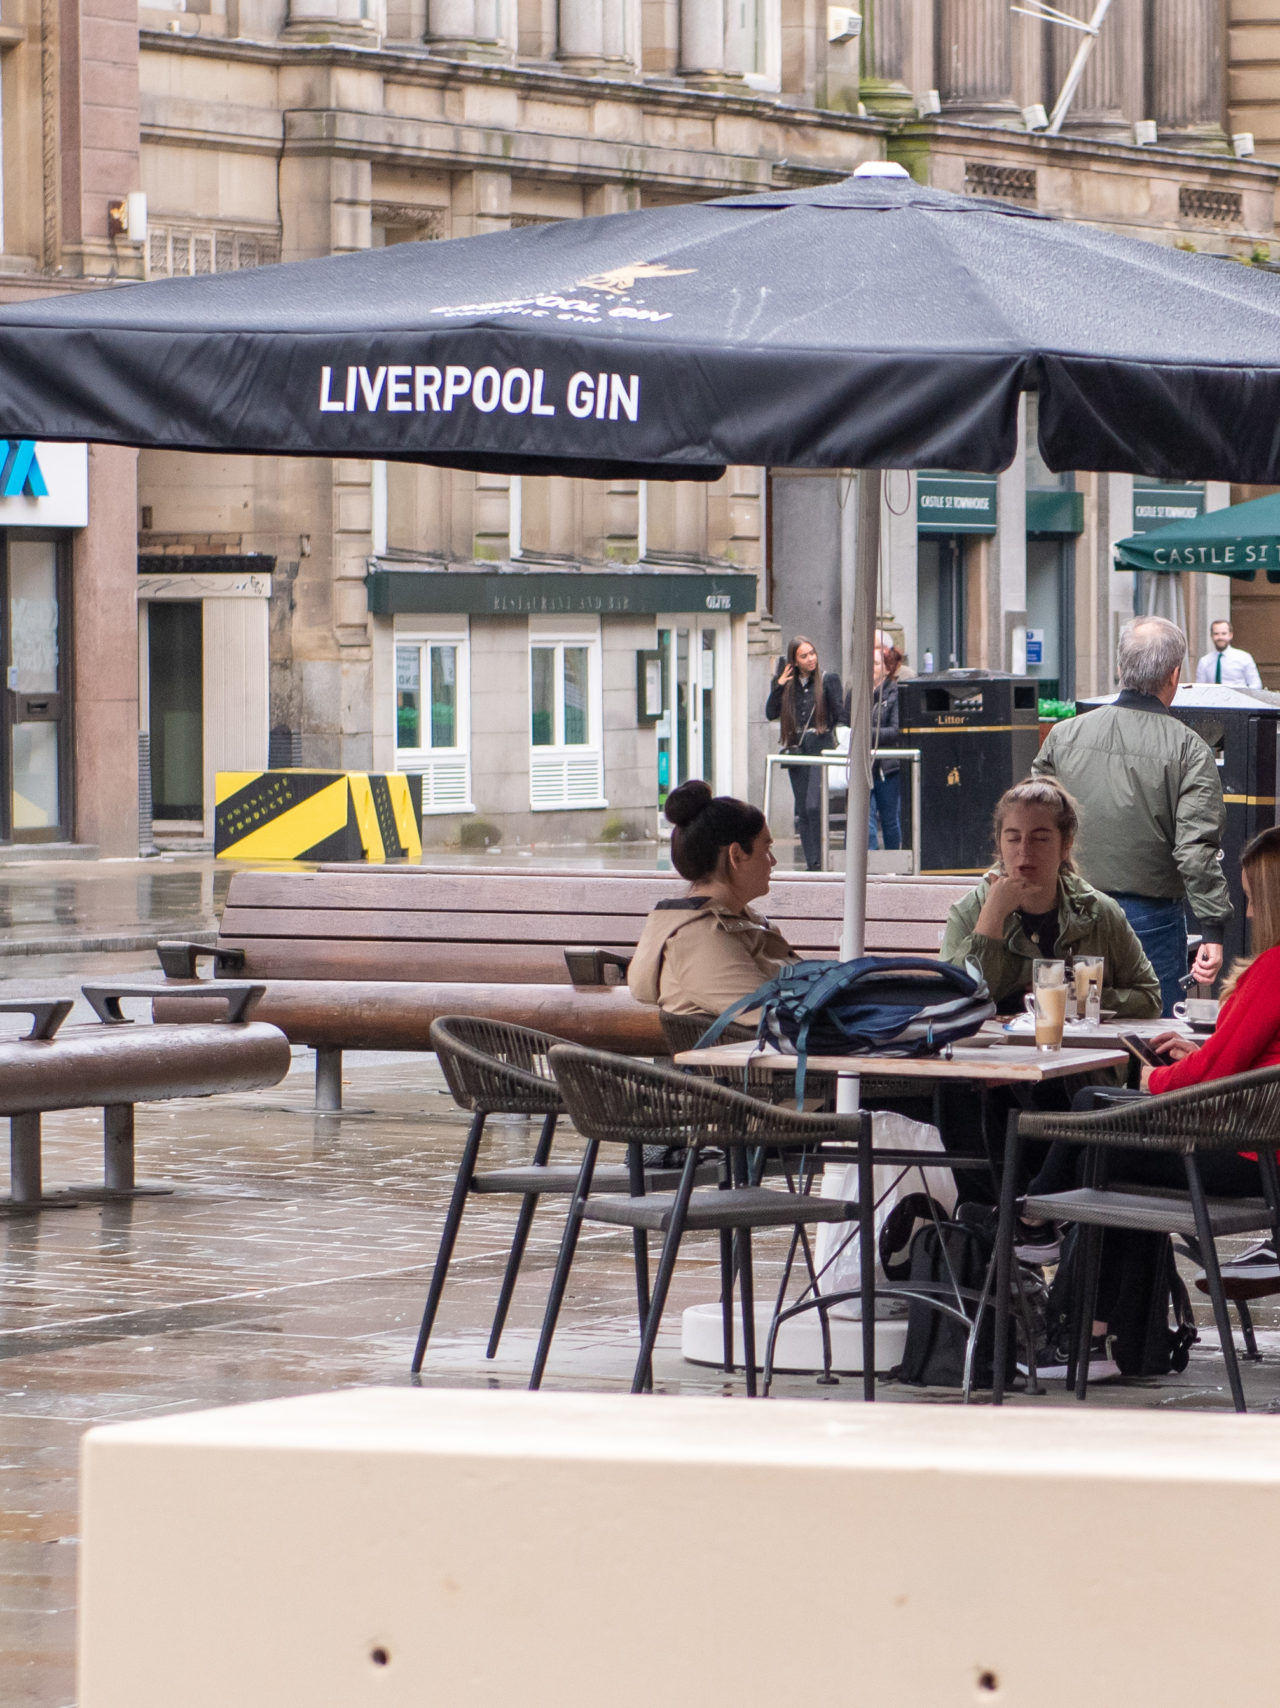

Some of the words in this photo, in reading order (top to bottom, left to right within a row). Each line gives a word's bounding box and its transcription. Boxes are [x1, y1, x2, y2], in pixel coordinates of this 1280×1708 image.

[320, 365, 556, 416] LIVERPOOL
[566, 371, 640, 422] GIN
[920, 495, 944, 508] CASTLE
[953, 496, 990, 510] TOWNHOUSE
[1135, 505, 1156, 517] CASTLE
[1153, 546, 1236, 565] CASTLE
[937, 715, 966, 725] Litter
